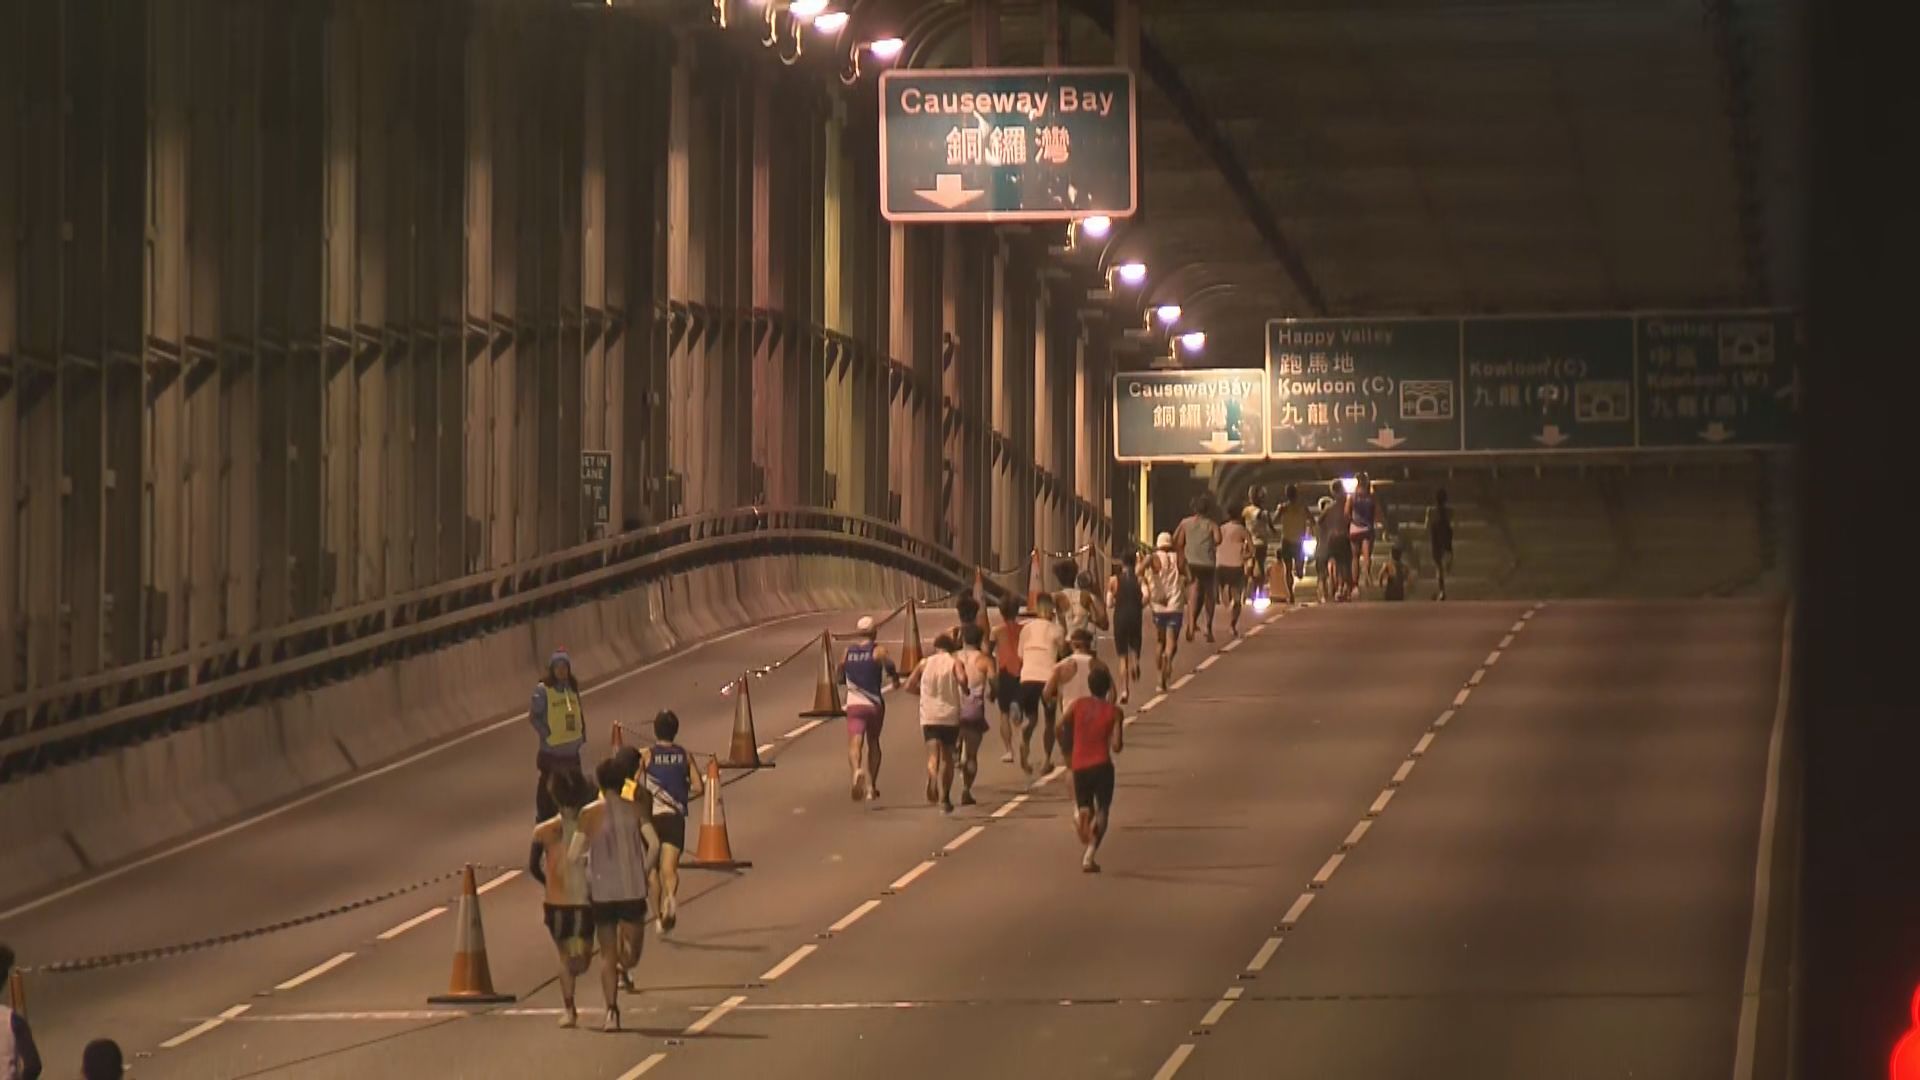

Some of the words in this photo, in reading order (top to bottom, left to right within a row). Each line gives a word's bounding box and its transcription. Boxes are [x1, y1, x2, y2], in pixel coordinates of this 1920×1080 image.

[901, 87, 1049, 117] Causeway
[1059, 86, 1115, 116] Bay
[946, 126, 1070, 165] 銅鑼灣
[1278, 328, 1335, 346] Happy
[1341, 327, 1394, 345] Valley
[1279, 352, 1355, 375] 跑馬地
[1278, 378, 1356, 396] Kowloon
[1362, 376, 1395, 395] (C)
